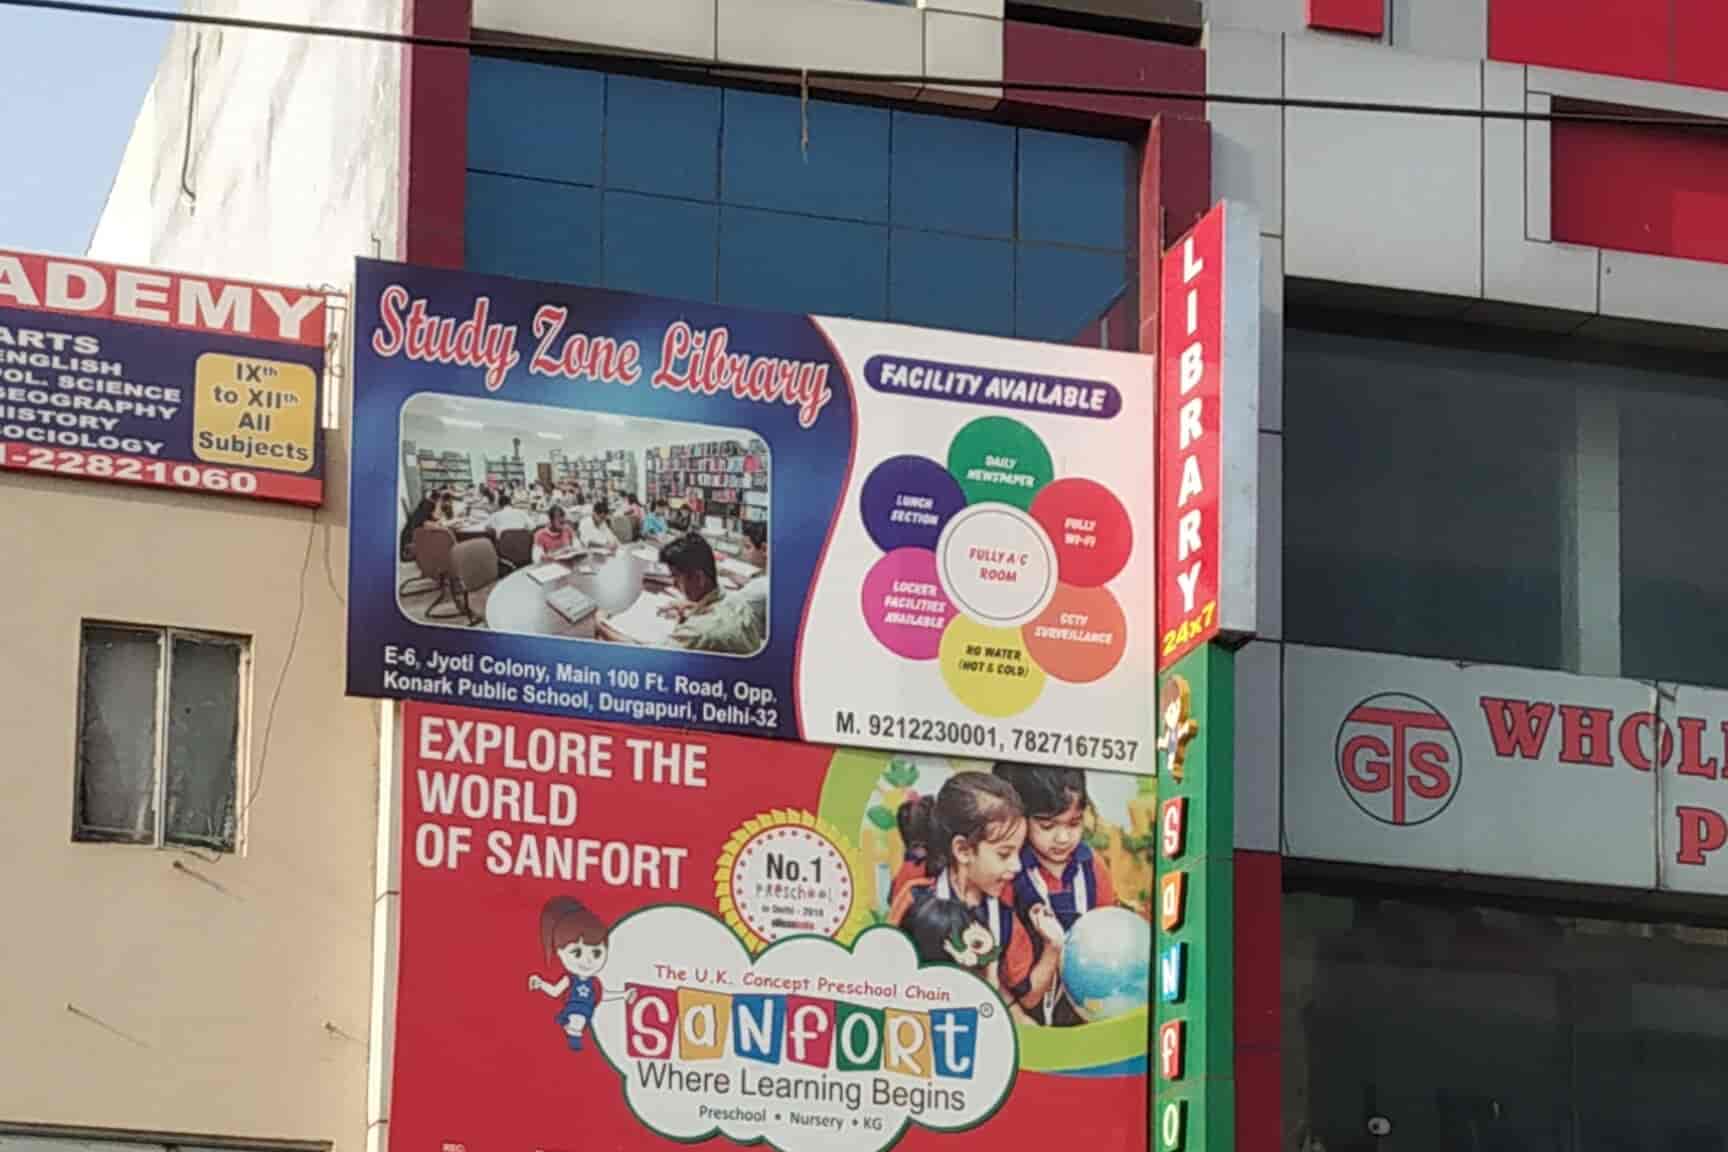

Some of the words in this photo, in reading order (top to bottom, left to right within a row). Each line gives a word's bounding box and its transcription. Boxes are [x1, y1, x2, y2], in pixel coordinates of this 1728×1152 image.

[0, 350, 122, 376] NGLISH
[373, 284, 519, 391] Study
[530, 303, 641, 384] Zone
[652, 321, 832, 429] Library
[0, 367, 48, 386] OL.
[58, 375, 181, 402] SCIENCE
[214, 386, 238, 404] to
[880, 362, 982, 396] FACILITY
[985, 377, 1106, 411] AVAILABLE
[0, 386, 177, 420] EOGRAPHY
[0, 404, 120, 431] ISTORY
[238, 412, 270, 432] All
[1178, 238, 1204, 612] LIBRARY
[0, 424, 163, 455] OCIOLOGY
[199, 431, 309, 461] Subjects
[969, 548, 1005, 564] FULLY
[979, 566, 1018, 583] ROOM
[985, 646, 1022, 661] WATER
[383, 645, 420, 669] E-6,
[426, 650, 475, 673] Jyoti
[479, 654, 551, 683] Colony,
[556, 663, 600, 685] Main
[607, 668, 640, 689] 100
[675, 675, 728, 701] Road,
[733, 681, 778, 706] Opp.
[383, 670, 453, 695] Konark
[458, 678, 519, 701] Public
[523, 684, 594, 712] School,
[599, 692, 698, 722] Durgapuri,
[702, 703, 778, 728] Delhi-32
[418, 715, 613, 778] EXPLORE
[626, 738, 708, 787] THE
[836, 710, 861, 735] M.
[868, 714, 1005, 752] 9212230001,
[1011, 728, 1139, 762] 7827167537
[416, 769, 577, 827] WORLD
[415, 823, 472, 869] OF
[487, 832, 689, 890] SANFORT
[766, 853, 822, 884] No.1
[654, 963, 688, 981] The
[694, 967, 734, 986] U.K.
[742, 971, 810, 992] Concept
[817, 976, 898, 998] Preschool
[904, 984, 951, 1001] Chain
[637, 1060, 730, 1095] Where
[742, 1068, 862, 1111] Learning
[872, 1077, 966, 1115] Begins
[699, 1104, 767, 1122] Preschool
[789, 1111, 844, 1131] Nursery
[863, 1117, 883, 1131] KG
